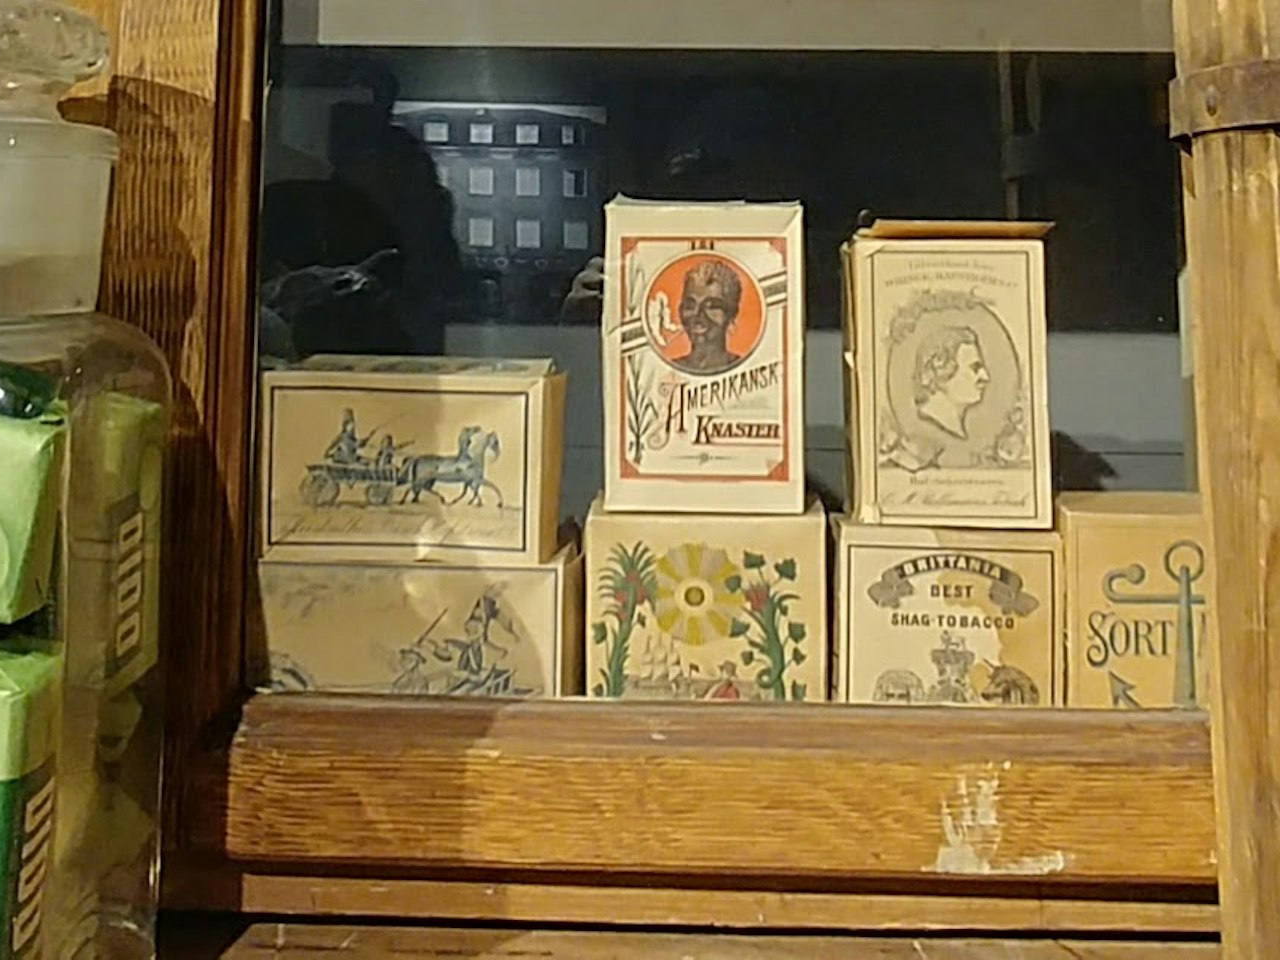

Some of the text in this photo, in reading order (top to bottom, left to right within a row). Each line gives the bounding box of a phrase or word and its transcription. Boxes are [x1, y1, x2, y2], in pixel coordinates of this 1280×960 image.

[648, 361, 780, 451] AMERIKANSK
[692, 414, 781, 445] KNASTER
[116, 511, 144, 658] DIDO
[902, 554, 1002, 579] BRITTANIA
[930, 584, 974, 599] BEST
[1086, 610, 1175, 668] SORT
